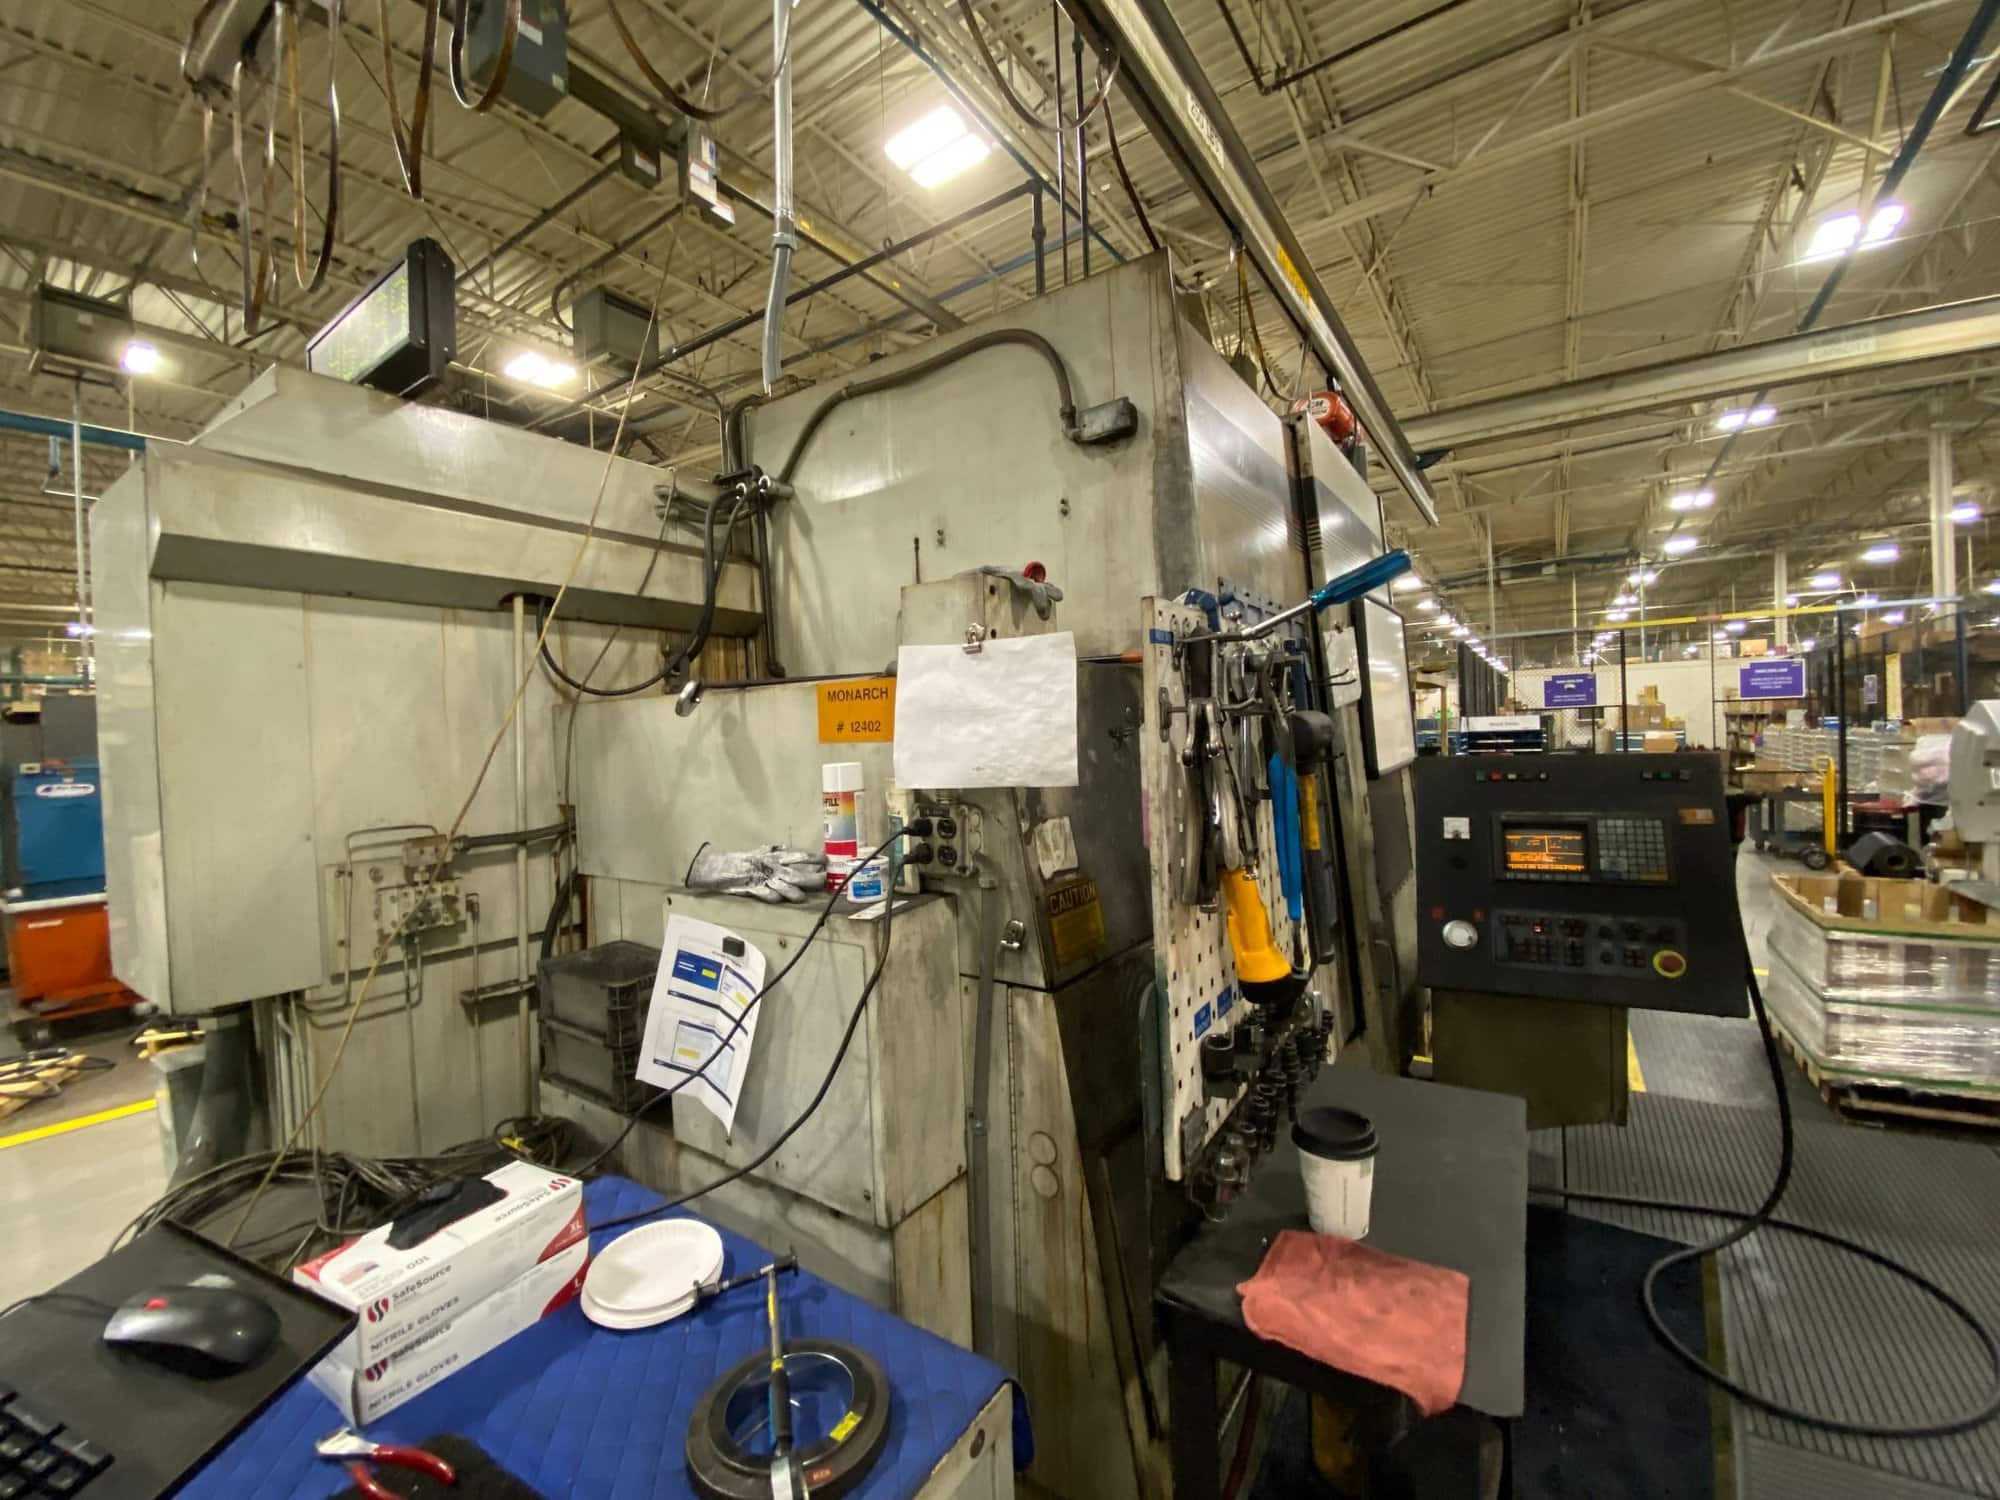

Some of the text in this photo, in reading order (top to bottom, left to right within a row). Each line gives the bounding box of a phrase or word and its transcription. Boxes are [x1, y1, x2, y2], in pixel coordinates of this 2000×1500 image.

[827, 686, 889, 702] MONARCH
[836, 720, 881, 734] # 12402
[1049, 879, 1096, 914] CAUTION
[392, 1264, 452, 1301] SafeSource
[370, 1322, 414, 1352] NITRILE
[416, 1295, 459, 1325] GLOVES
[368, 1352, 459, 1411] NITRILE GLOVES
